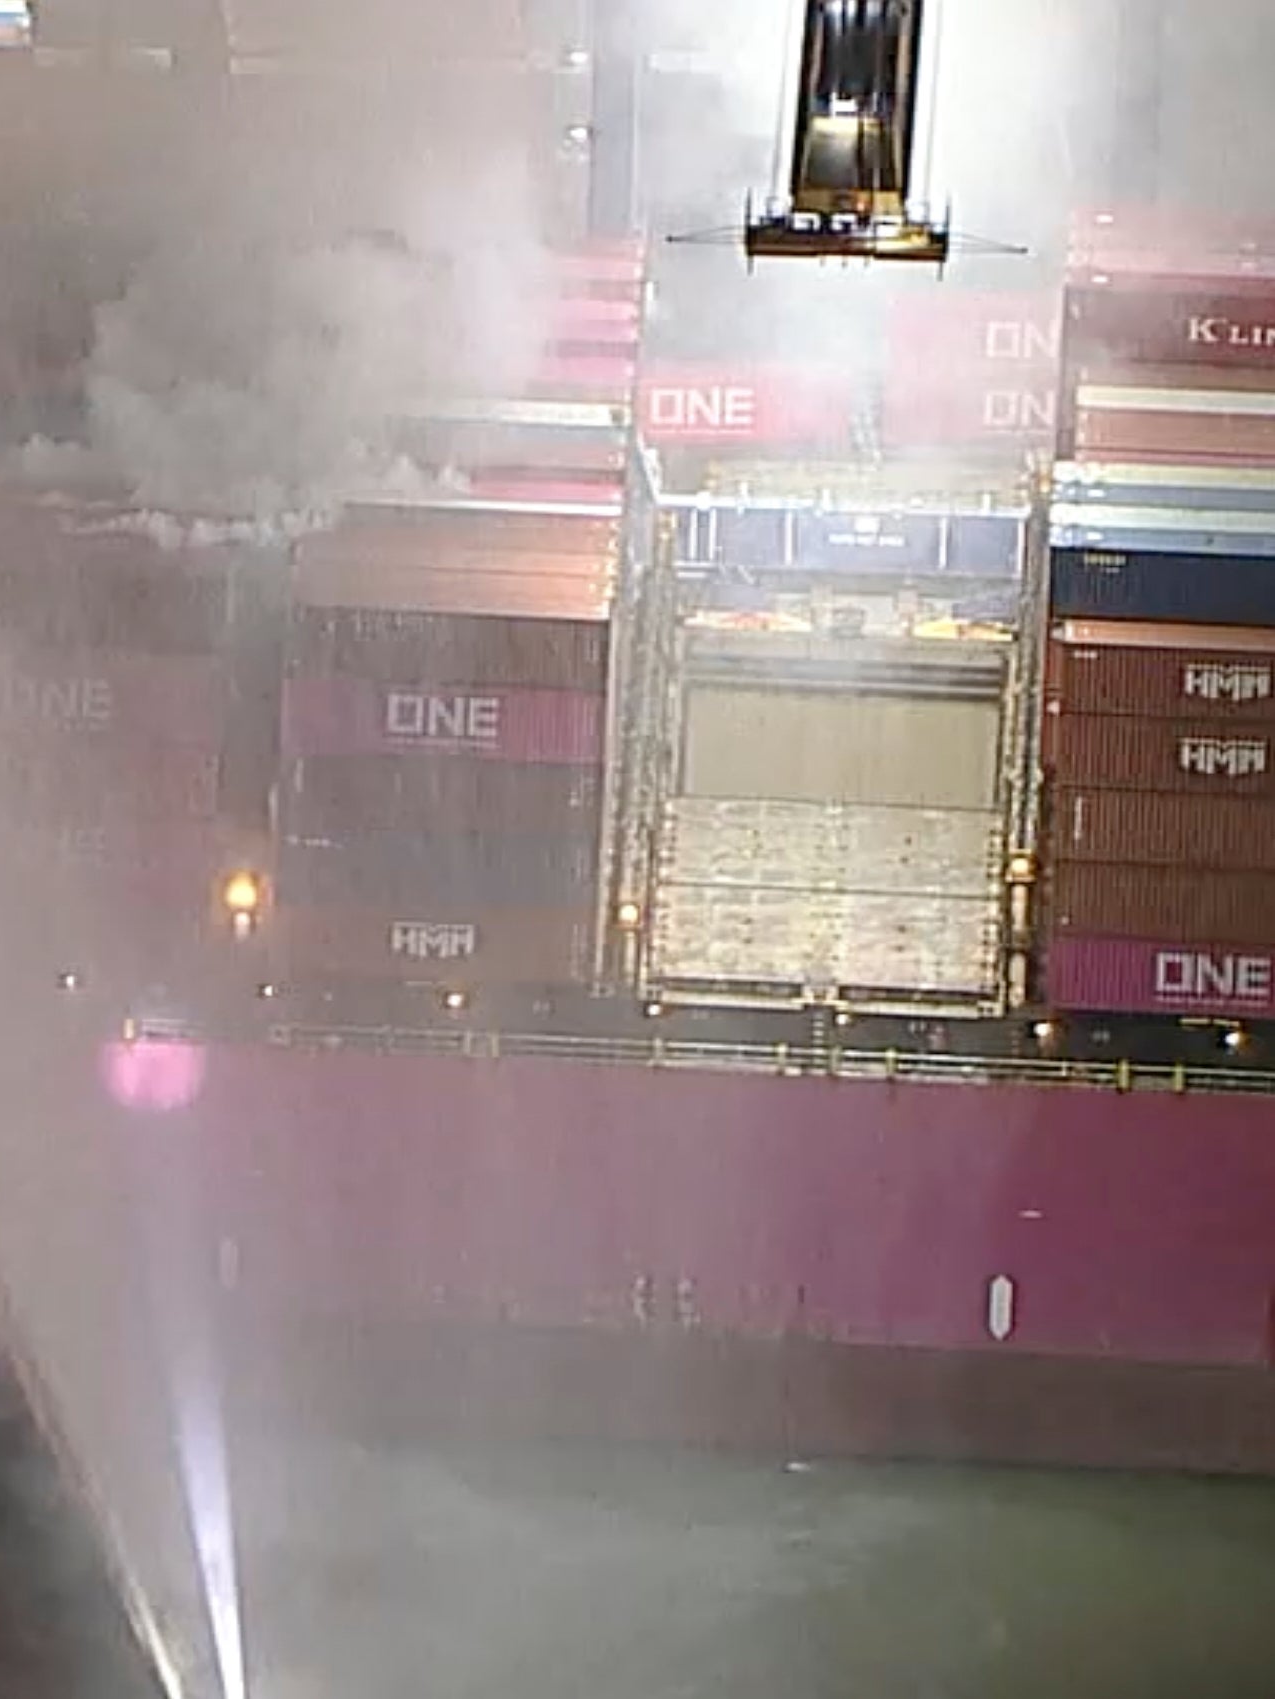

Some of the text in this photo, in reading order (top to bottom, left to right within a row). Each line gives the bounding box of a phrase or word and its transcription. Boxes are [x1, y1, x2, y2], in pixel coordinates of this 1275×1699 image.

[651, 387, 753, 424] ONE
[1185, 664, 1271, 701] HMM
[387, 694, 500, 737] ONE
[1180, 738, 1267, 775] HMM
[391, 923, 475, 958] HMM
[1155, 953, 1272, 995] ONE
